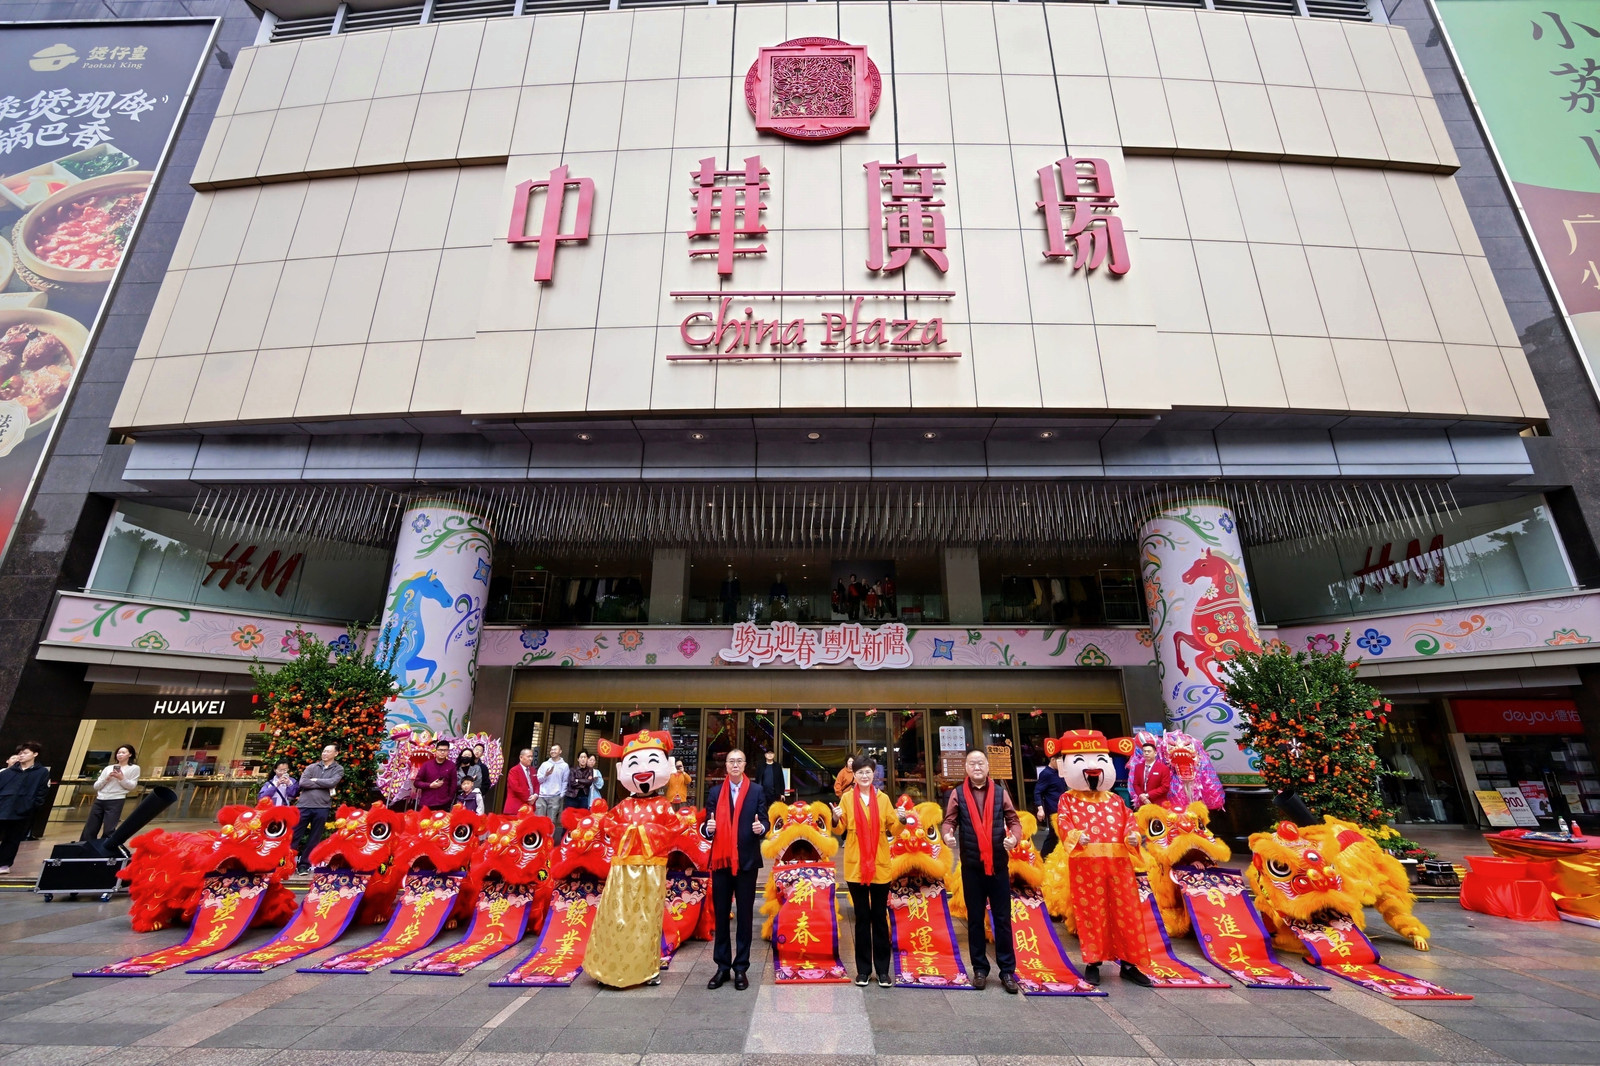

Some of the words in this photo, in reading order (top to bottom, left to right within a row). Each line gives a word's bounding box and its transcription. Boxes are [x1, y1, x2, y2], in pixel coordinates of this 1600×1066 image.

[82, 62, 115, 70] Paotsai
[119, 61, 143, 70] King
[86, 45, 148, 61] 煲仔皇
[680, 296, 807, 353] China
[821, 296, 948, 348] Plaza
[202, 543, 303, 597] H&M
[722, 623, 817, 666] 骏马迎春
[818, 623, 909, 667] 粤见新禧
[153, 700, 226, 715] HUAWEI
[789, 877, 820, 970] 新春吉
